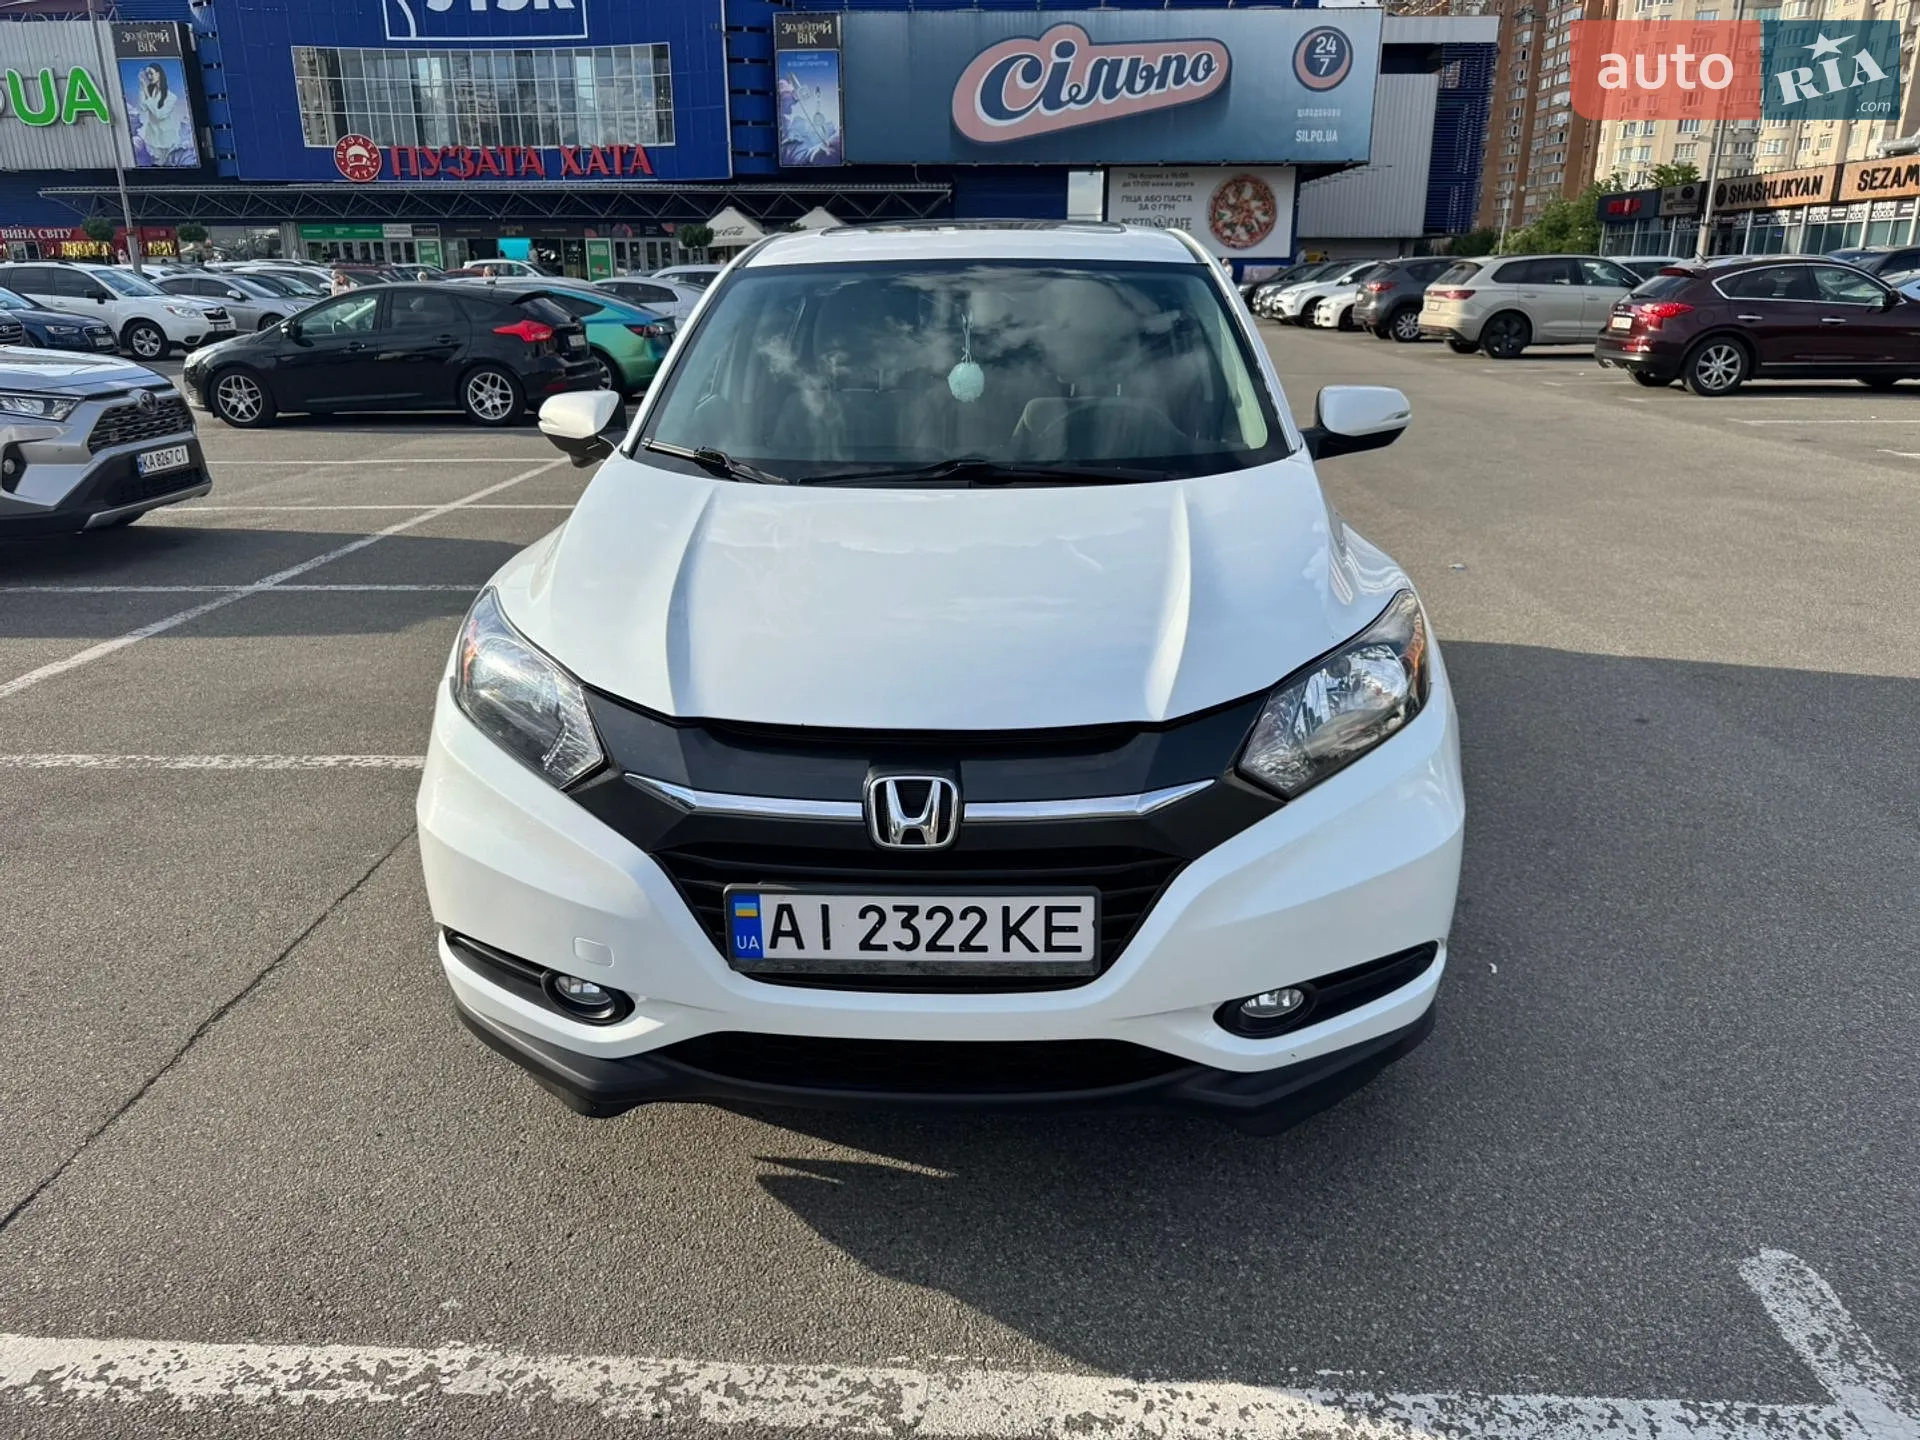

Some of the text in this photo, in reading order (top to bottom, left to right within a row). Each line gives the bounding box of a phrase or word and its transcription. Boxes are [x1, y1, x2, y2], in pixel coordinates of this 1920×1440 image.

[1315, 36, 1337, 54] 24
[977, 38, 1217, 124] Сільпо
[1296, 129, 1338, 143] SILPO.UA
[389, 143, 653, 178] ПУЗАТА ХАТА
[1163, 195, 1193, 203] ПАСТА
[1727, 175, 1824, 205] SHASHLIKYAN
[38, 227, 73, 239] СВІТУ
[768, 903, 1083, 953] AI 2322 KE
[736, 934, 760, 950] UA
